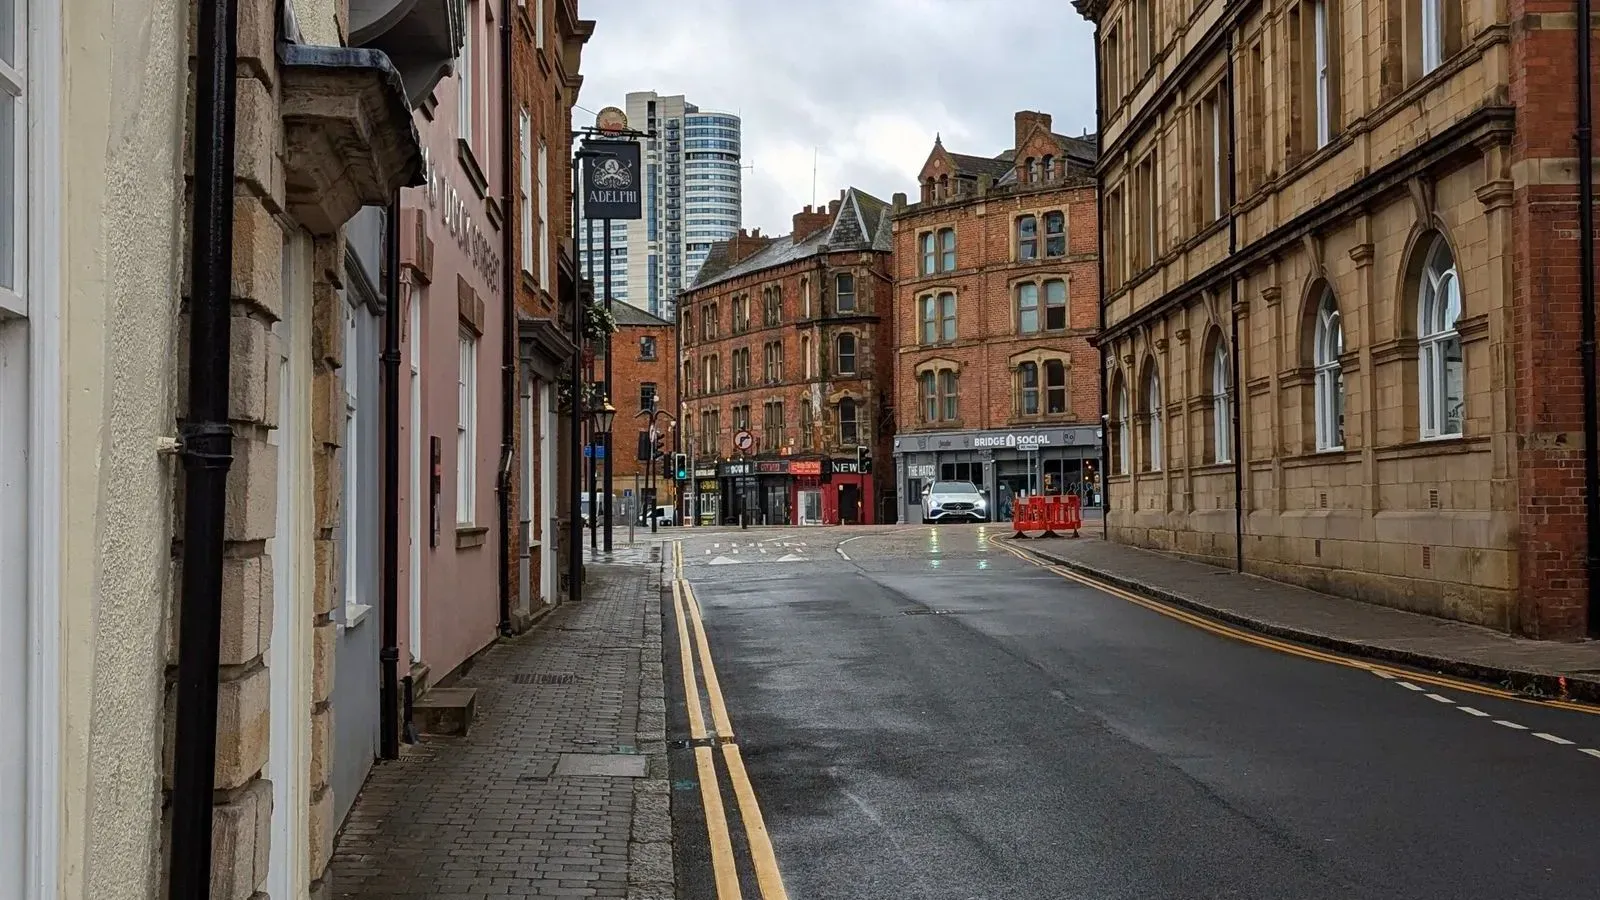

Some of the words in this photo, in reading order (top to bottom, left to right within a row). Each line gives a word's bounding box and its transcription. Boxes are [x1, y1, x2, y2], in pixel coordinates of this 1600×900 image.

[589, 190, 638, 203] ADELPHI
[442, 176, 471, 257] DOCK
[974, 436, 1005, 447] BRIDGE
[1016, 434, 1050, 445] SOCIAL
[832, 461, 858, 473] NEW
[908, 465, 918, 477] THE
